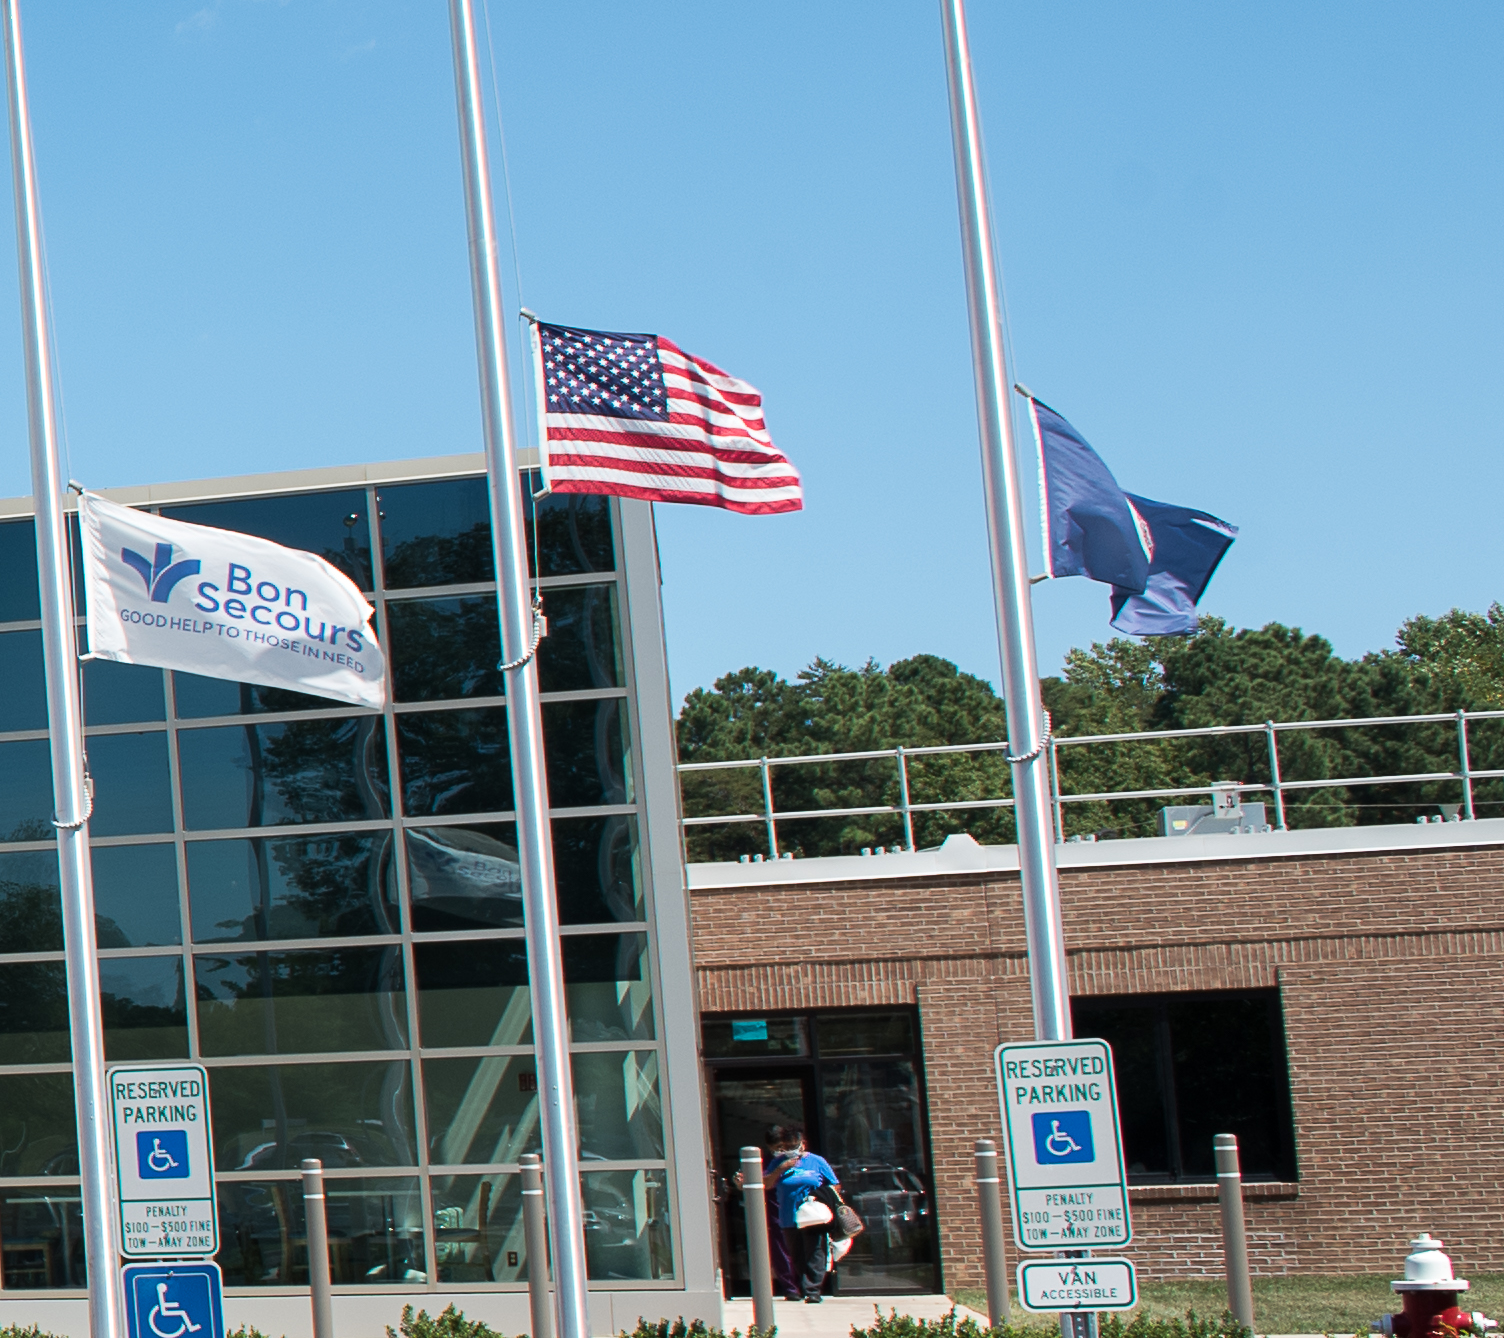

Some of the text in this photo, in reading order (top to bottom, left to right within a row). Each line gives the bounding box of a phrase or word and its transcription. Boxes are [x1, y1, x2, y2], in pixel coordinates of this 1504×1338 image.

[227, 562, 308, 611] Bon
[194, 581, 364, 653] Secours
[120, 609, 364, 673] GOOD HELP TO THOSE IN NEED
[1006, 1056, 1104, 1079] RESERVED
[116, 1080, 200, 1100] RESERVED
[1015, 1082, 1100, 1104] PARKING
[123, 1104, 197, 1124] PARKING
[1045, 1193, 1093, 1206] PENALTY
[145, 1205, 187, 1217] PENALTY
[1096, 1208, 1122, 1221] FINE
[189, 1220, 211, 1232] FINE
[1094, 1225, 1121, 1238] ZONE
[187, 1236, 210, 1247] ZONE
[1058, 1271, 1097, 1285] VAN
[1041, 1287, 1117, 1300] ACCESSIBLE
